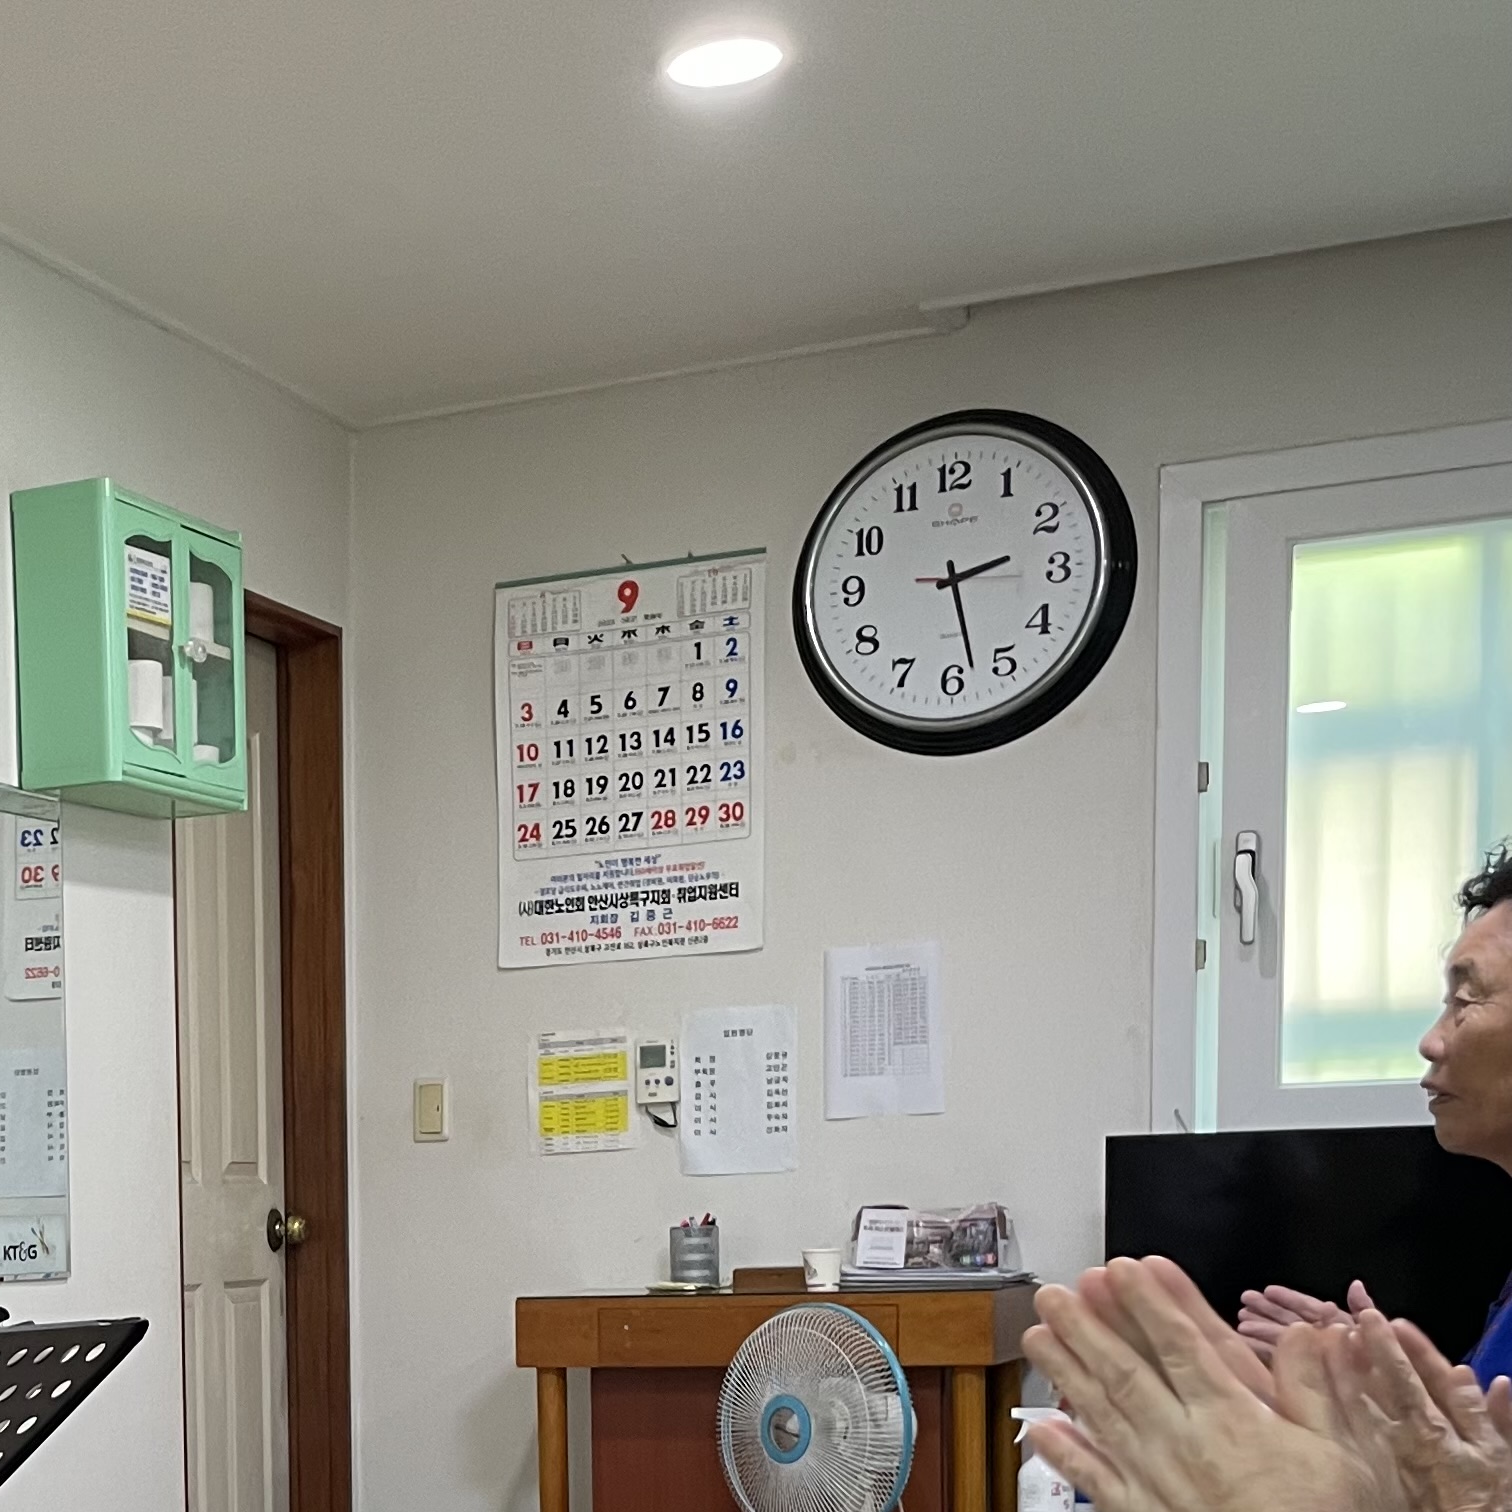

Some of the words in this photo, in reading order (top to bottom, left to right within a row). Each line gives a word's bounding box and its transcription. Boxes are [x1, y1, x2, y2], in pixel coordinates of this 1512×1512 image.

[938, 460, 972, 493] 12
[1000, 467, 1014, 498] 1
[893, 482, 919, 513] 11
[1032, 502, 1060, 535] 2
[854, 526, 884, 557] 10
[1046, 552, 1072, 583] 3
[618, 580, 639, 614] 9
[842, 576, 866, 606] 9
[1025, 603, 1052, 635] 4
[694, 642, 701, 660] 1
[726, 637, 738, 658] 2
[854, 625, 880, 655] 8
[892, 658, 916, 688] 7
[992, 644, 1017, 676] 5
[941, 665, 964, 696] 6
[521, 703, 533, 721] 3
[557, 699, 569, 718] 4
[590, 694, 602, 714] 5
[624, 691, 636, 710] 6
[658, 686, 670, 707] 7
[692, 682, 704, 702] 8
[726, 678, 738, 698] 9
[517, 744, 538, 762] 10
[554, 739, 574, 758] 11
[585, 734, 608, 755] 12
[619, 731, 642, 752] 13
[653, 726, 676, 748] 14
[686, 722, 710, 744] 15
[720, 719, 744, 740] 16
[517, 782, 540, 803] 17
[552, 779, 575, 800] 18
[586, 776, 608, 796] 19
[618, 772, 644, 792] 20
[654, 768, 676, 788] 21
[686, 764, 712, 786] 22
[720, 760, 745, 782] 23
[517, 823, 542, 842] 24
[552, 818, 577, 840] 25
[586, 816, 610, 836] 26
[618, 812, 644, 832] 27
[650, 810, 676, 830] 28
[685, 806, 710, 826] 29
[718, 802, 744, 823] 30
[540, 926, 622, 945] 031-410-4546
[658, 916, 738, 936] 031-410-6622
[3, 1241, 38, 1262] KT&G
